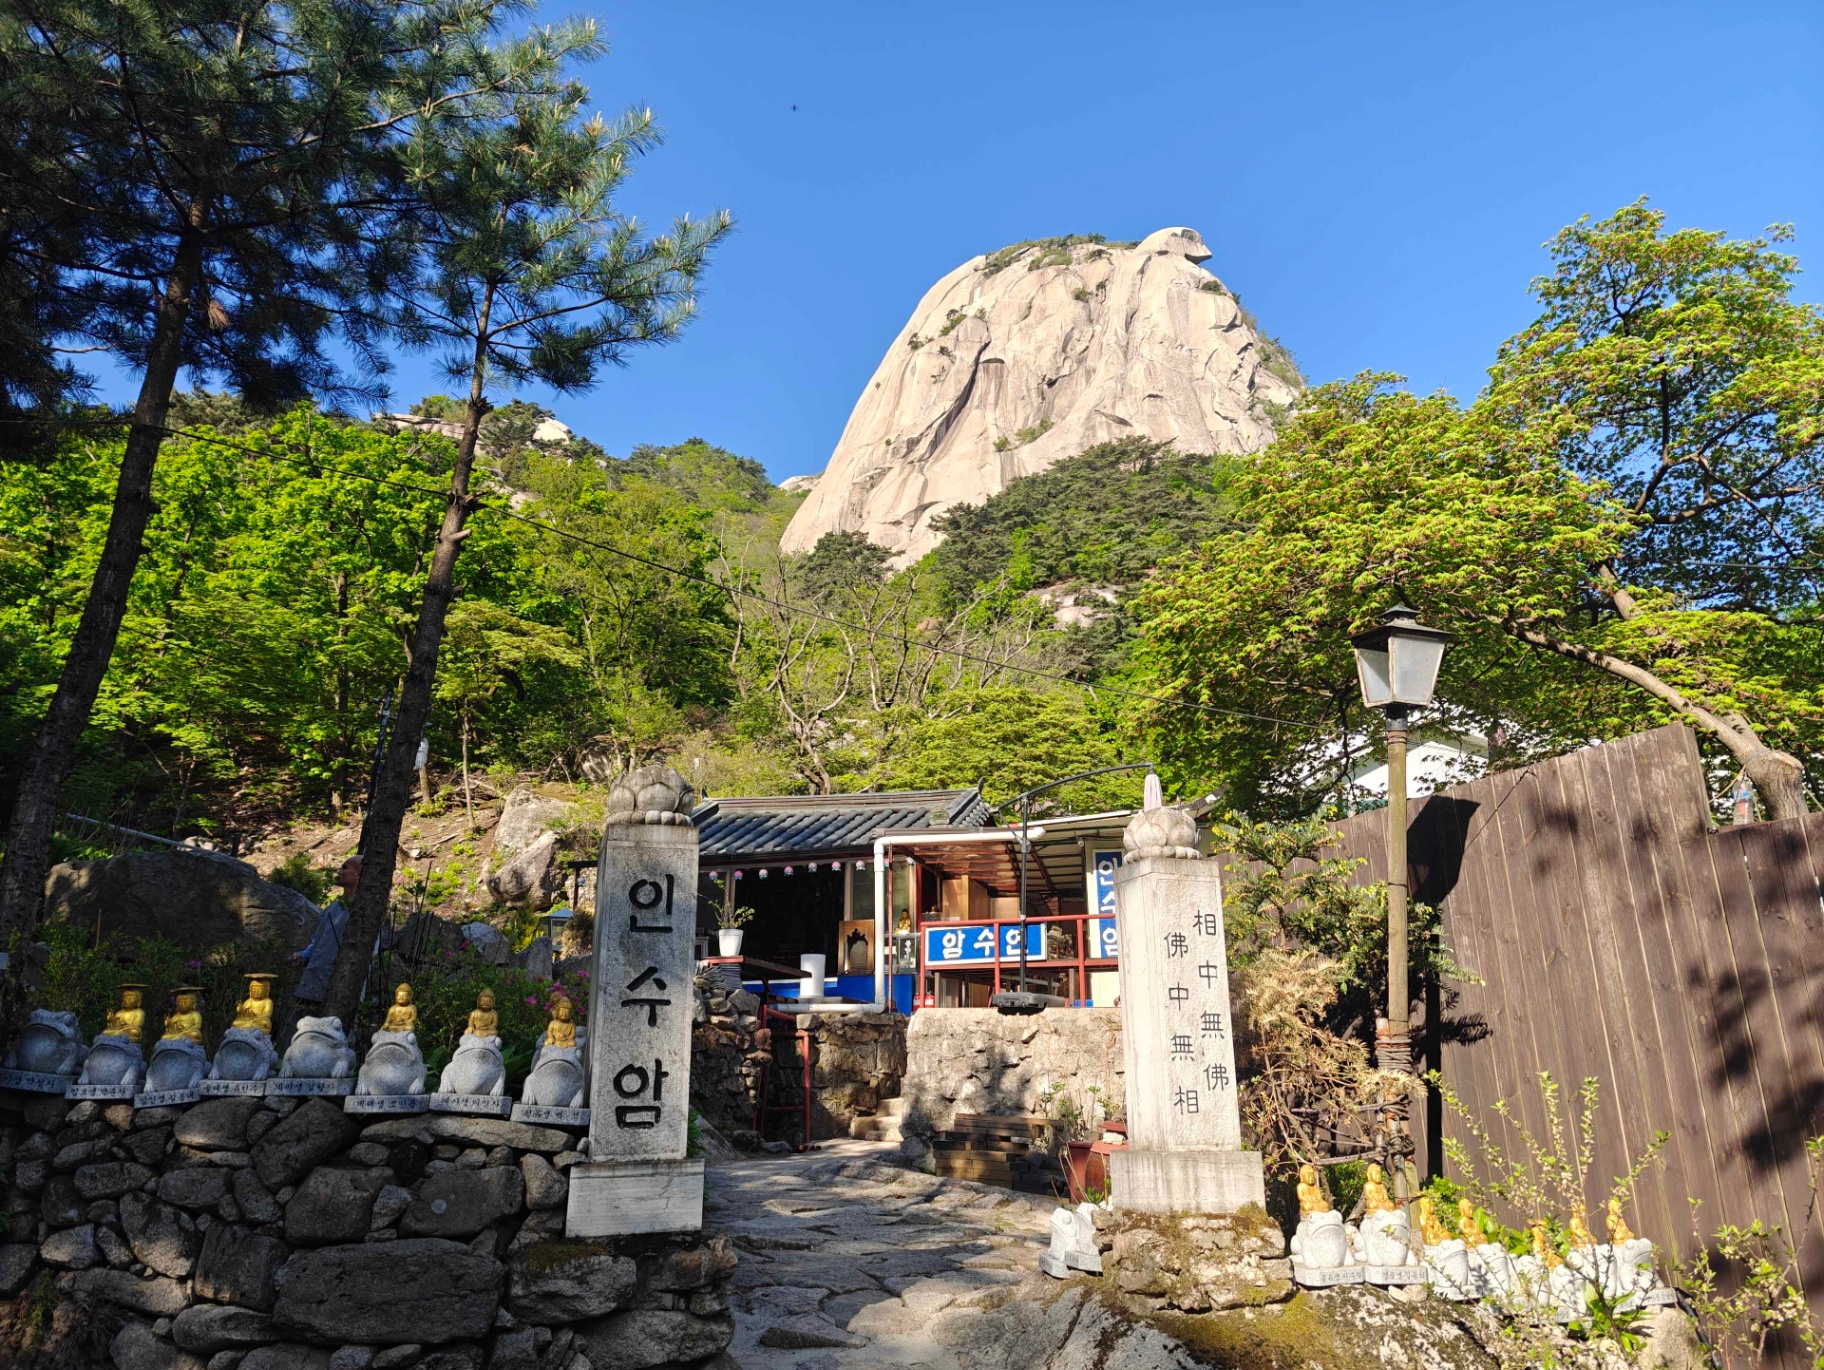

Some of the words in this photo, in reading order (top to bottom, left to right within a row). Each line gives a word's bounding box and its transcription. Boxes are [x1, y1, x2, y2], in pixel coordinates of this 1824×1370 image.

[614, 873, 675, 1130] 인수암
[1163, 931, 1200, 1116] 佛中無相
[1192, 909, 1230, 1092] 相中無佛
